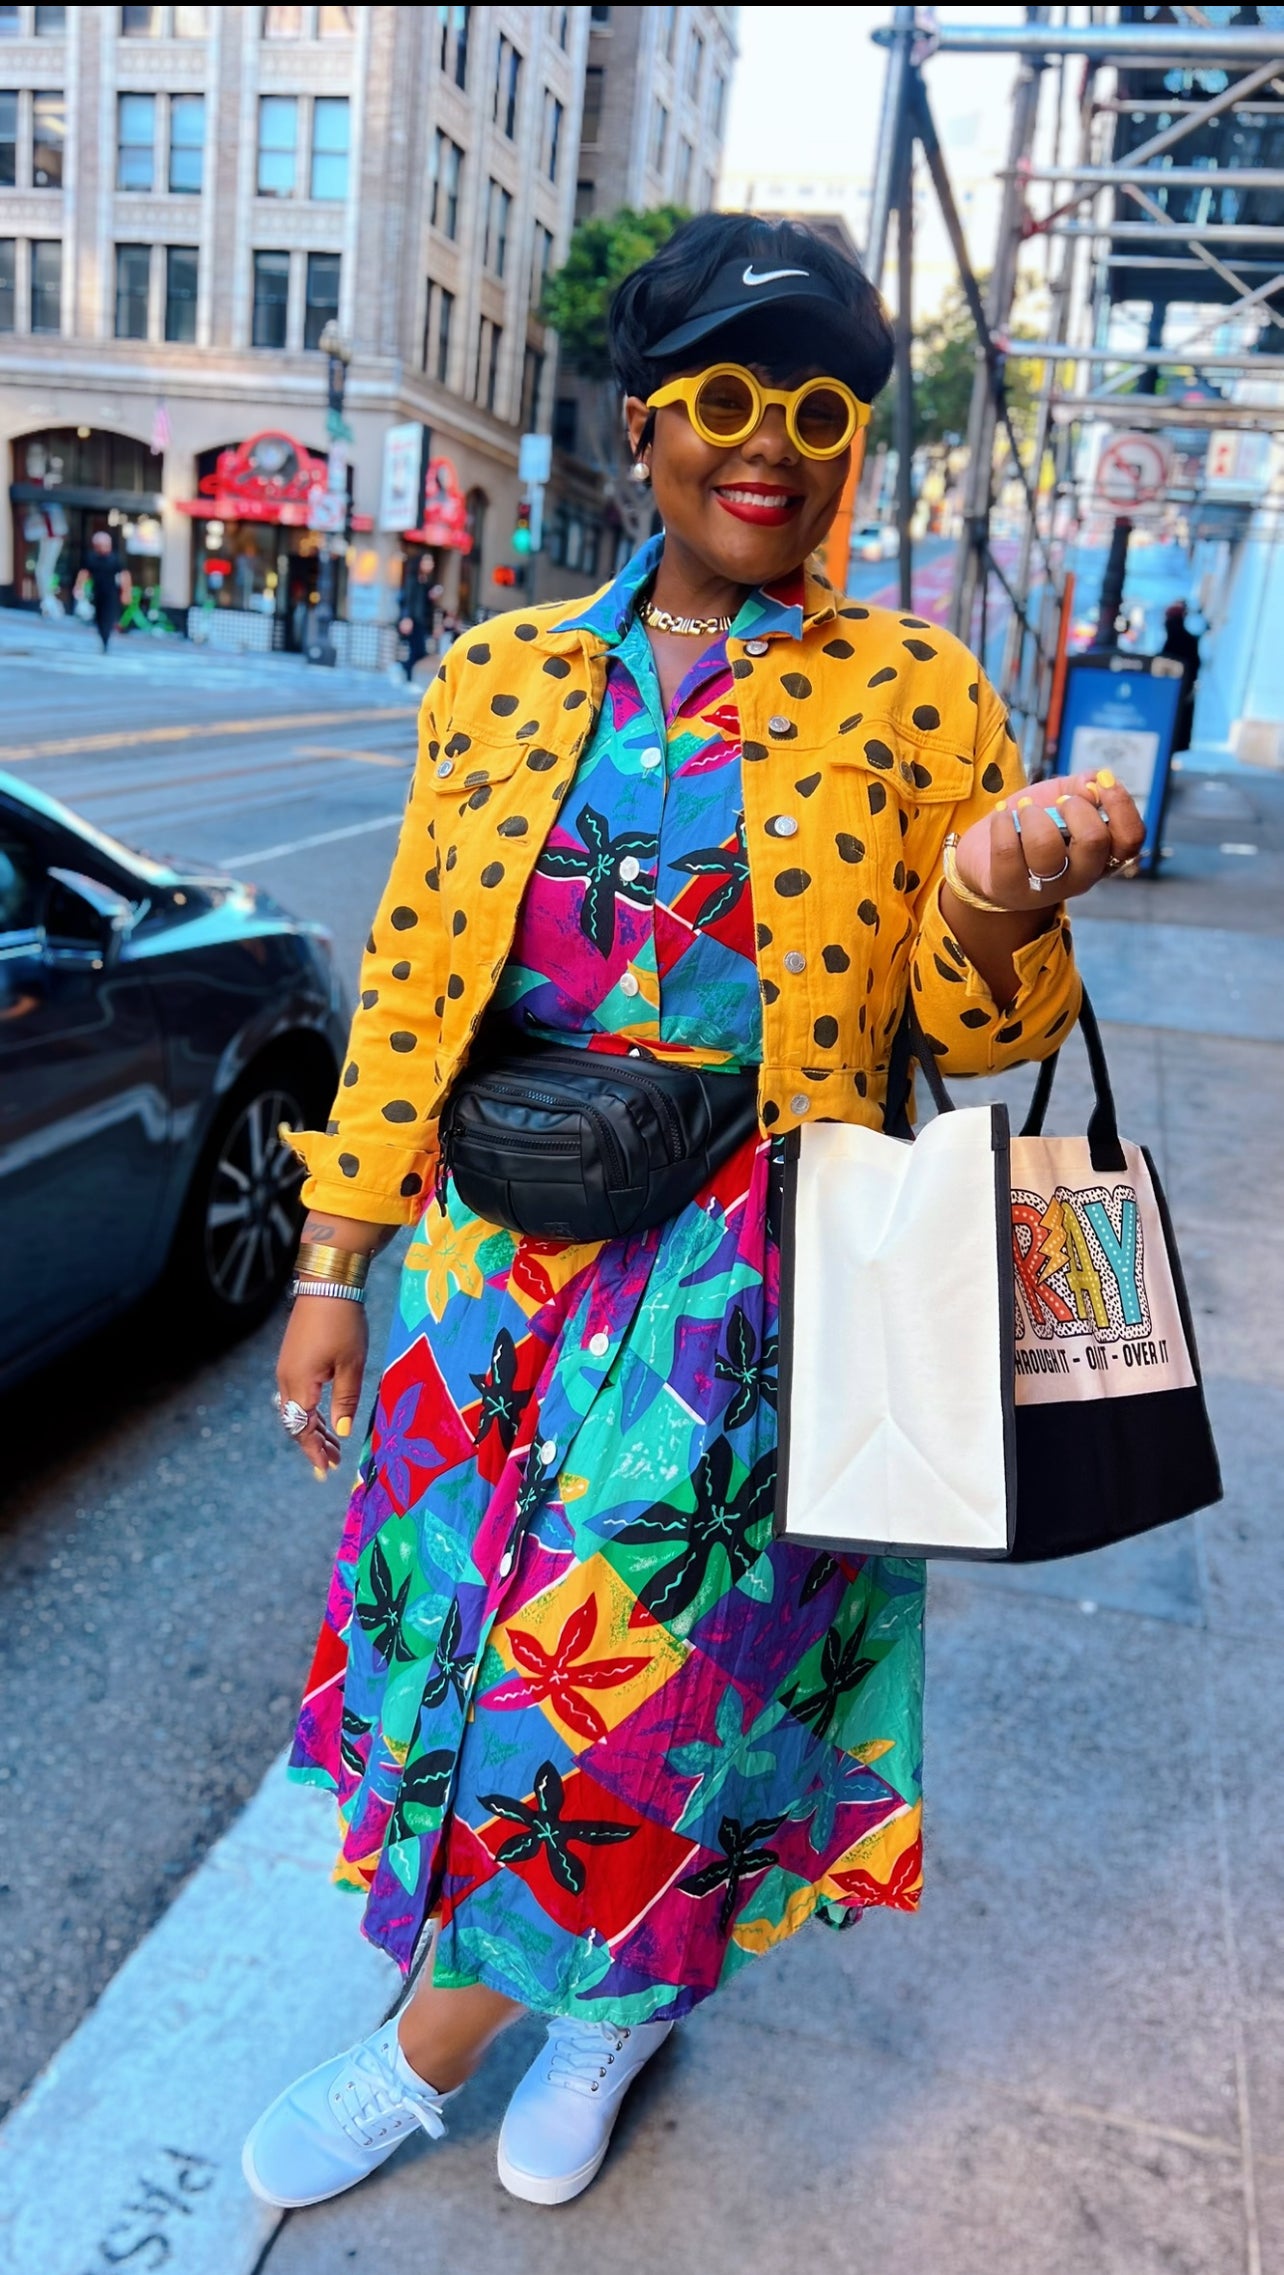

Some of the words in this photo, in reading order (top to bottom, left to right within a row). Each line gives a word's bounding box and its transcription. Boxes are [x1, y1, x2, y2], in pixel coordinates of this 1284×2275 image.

[1011, 1192, 1146, 1335] RAY
[1014, 1349, 1061, 1375] HROUGH
[1122, 1341, 1158, 1367] OVER
[1158, 1340, 1169, 1363] IT
